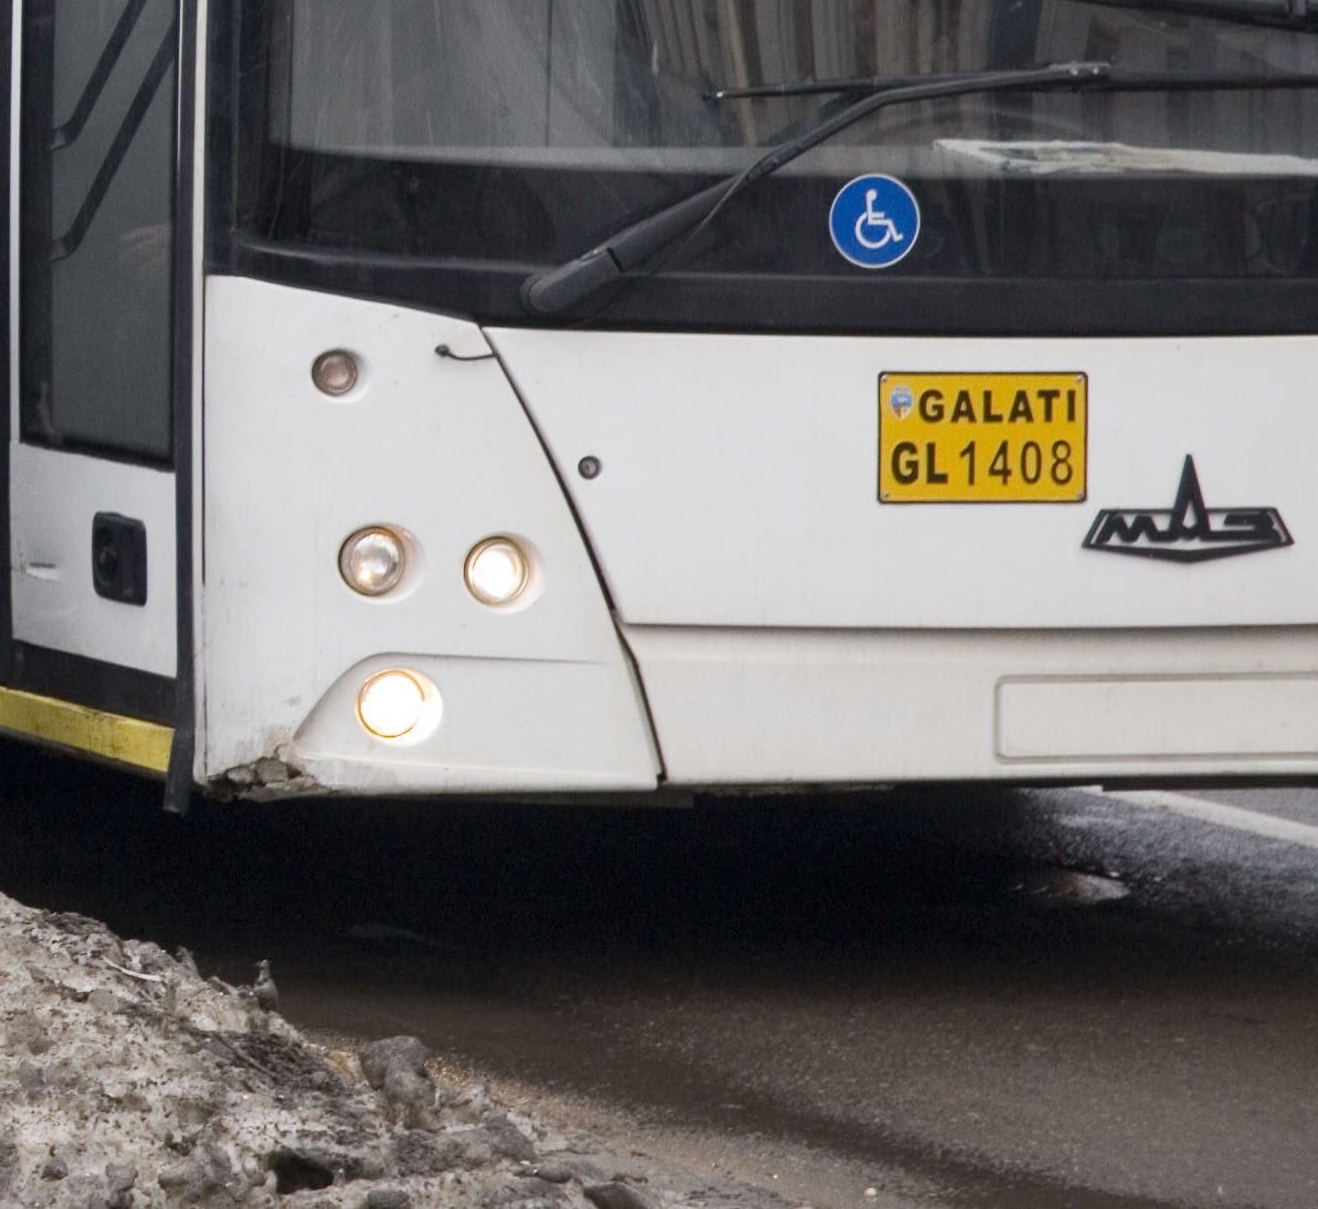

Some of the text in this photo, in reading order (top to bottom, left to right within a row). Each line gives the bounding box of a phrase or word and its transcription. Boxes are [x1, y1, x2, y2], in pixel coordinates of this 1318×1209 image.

[918, 388, 1077, 424] GALATI
[890, 438, 1074, 487] GL 1408
